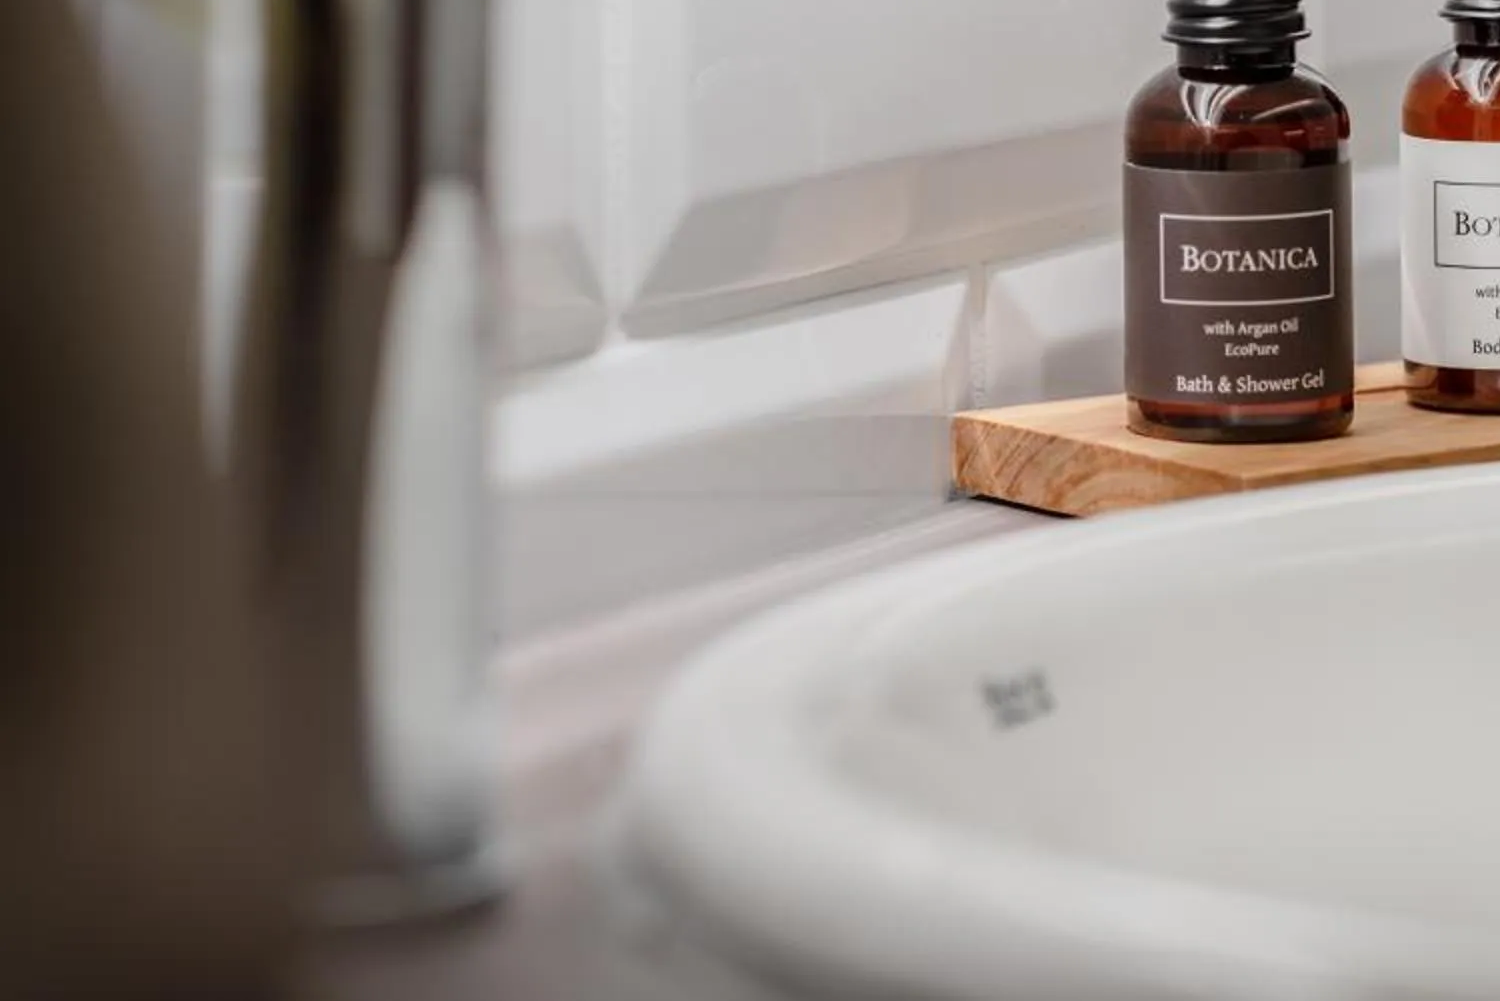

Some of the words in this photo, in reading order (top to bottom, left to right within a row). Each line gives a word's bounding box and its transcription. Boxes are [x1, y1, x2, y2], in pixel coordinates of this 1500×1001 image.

[1179, 244, 1319, 272] BOTANICA
[1203, 319, 1234, 336] with
[1238, 320, 1278, 338] Argan
[1280, 317, 1299, 333] Oil
[1224, 342, 1280, 357] EcoPure
[1176, 374, 1214, 393] Bath
[1217, 376, 1232, 394] &
[1236, 375, 1299, 394] Shower
[1301, 368, 1325, 388] Gel
